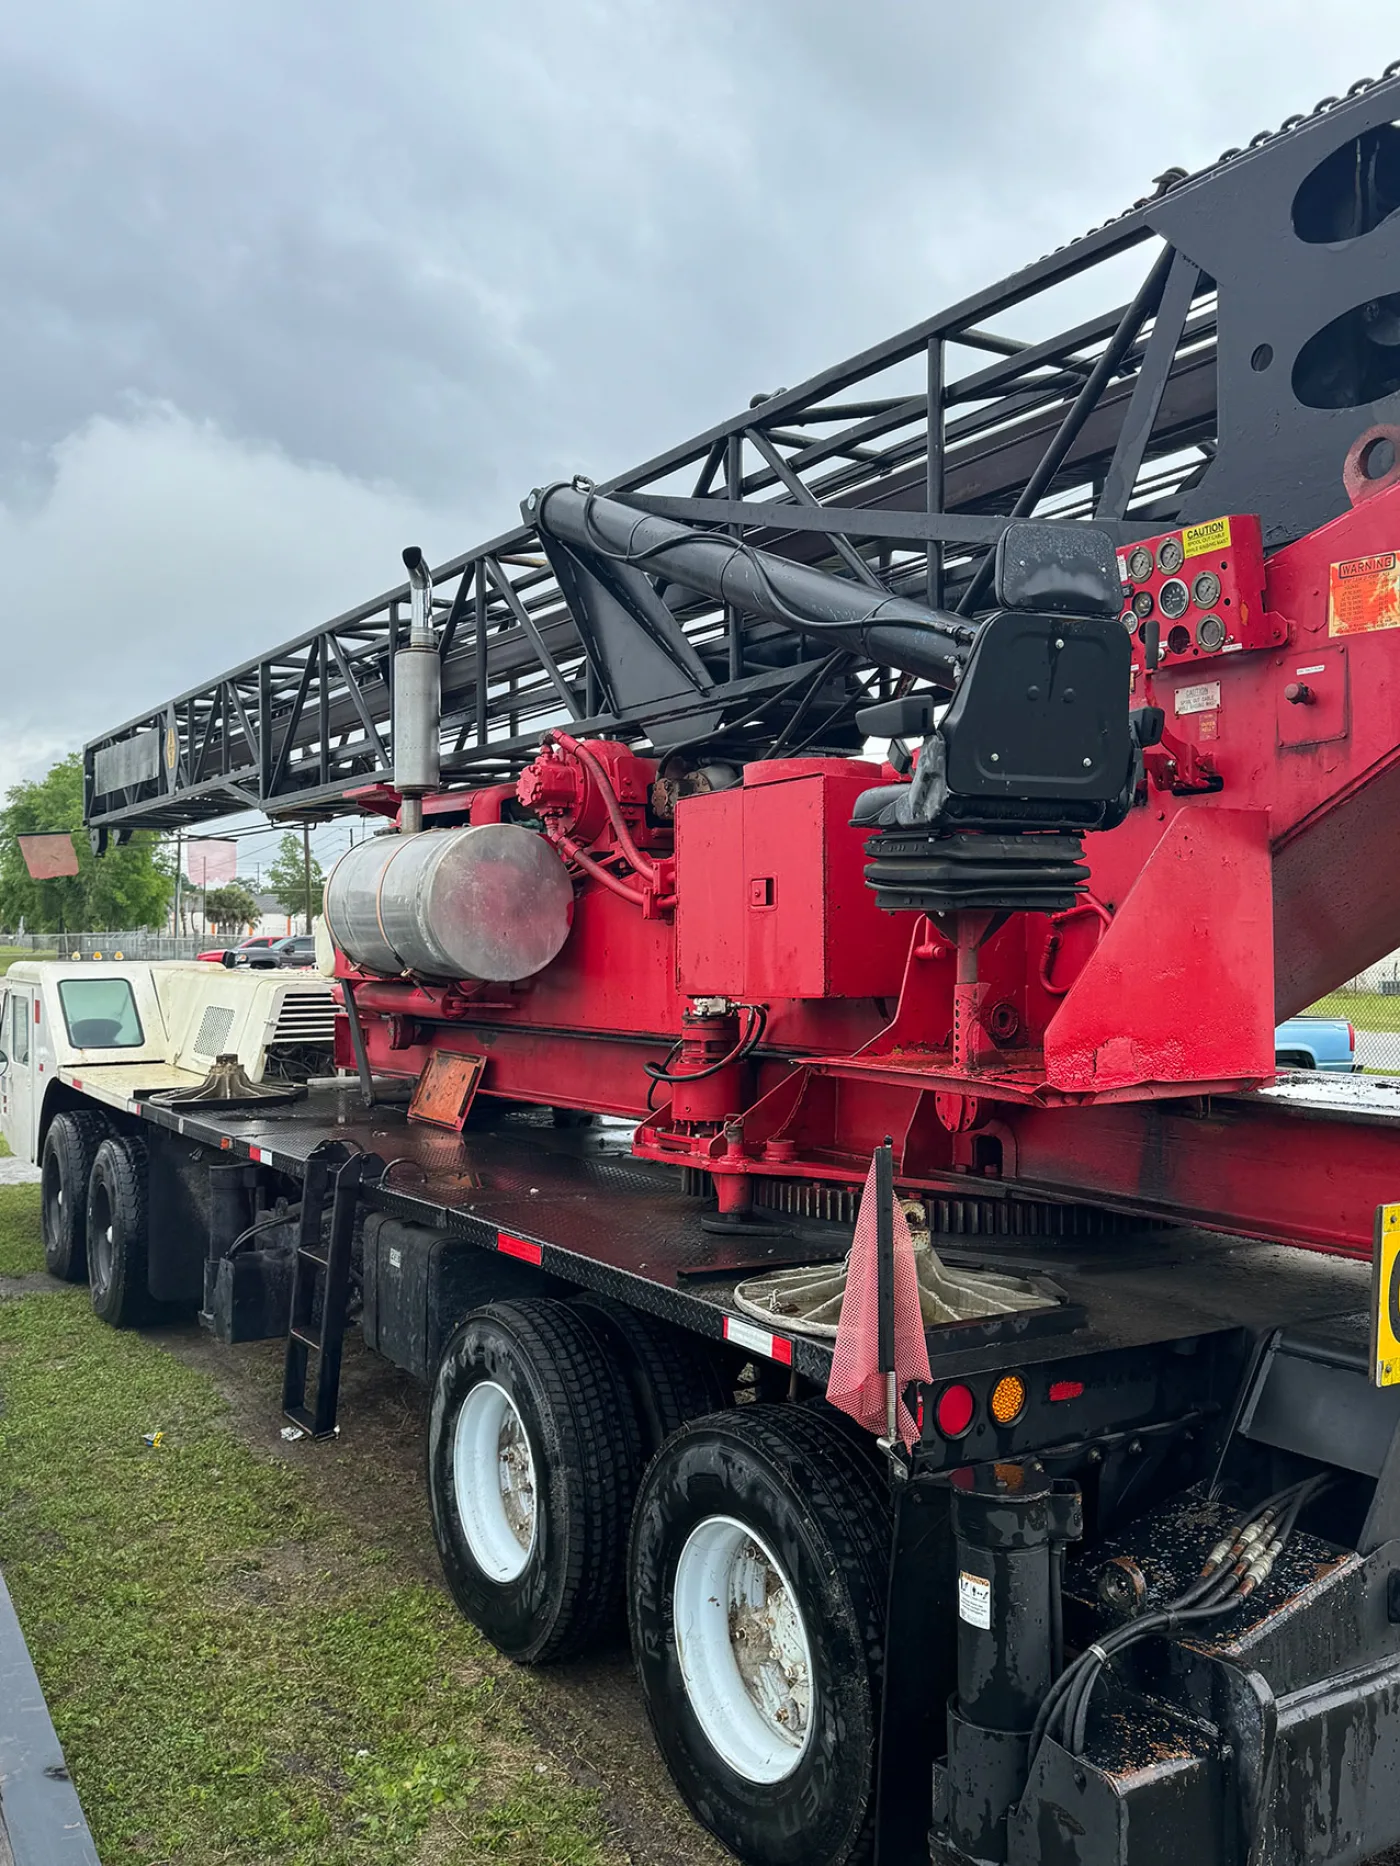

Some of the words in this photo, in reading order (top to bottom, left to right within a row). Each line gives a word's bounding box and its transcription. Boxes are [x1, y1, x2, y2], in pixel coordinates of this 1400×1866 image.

[1187, 521, 1224, 540] CAUTION
[1342, 557, 1392, 576] WARNING
[1186, 688, 1208, 697] CAUTION
